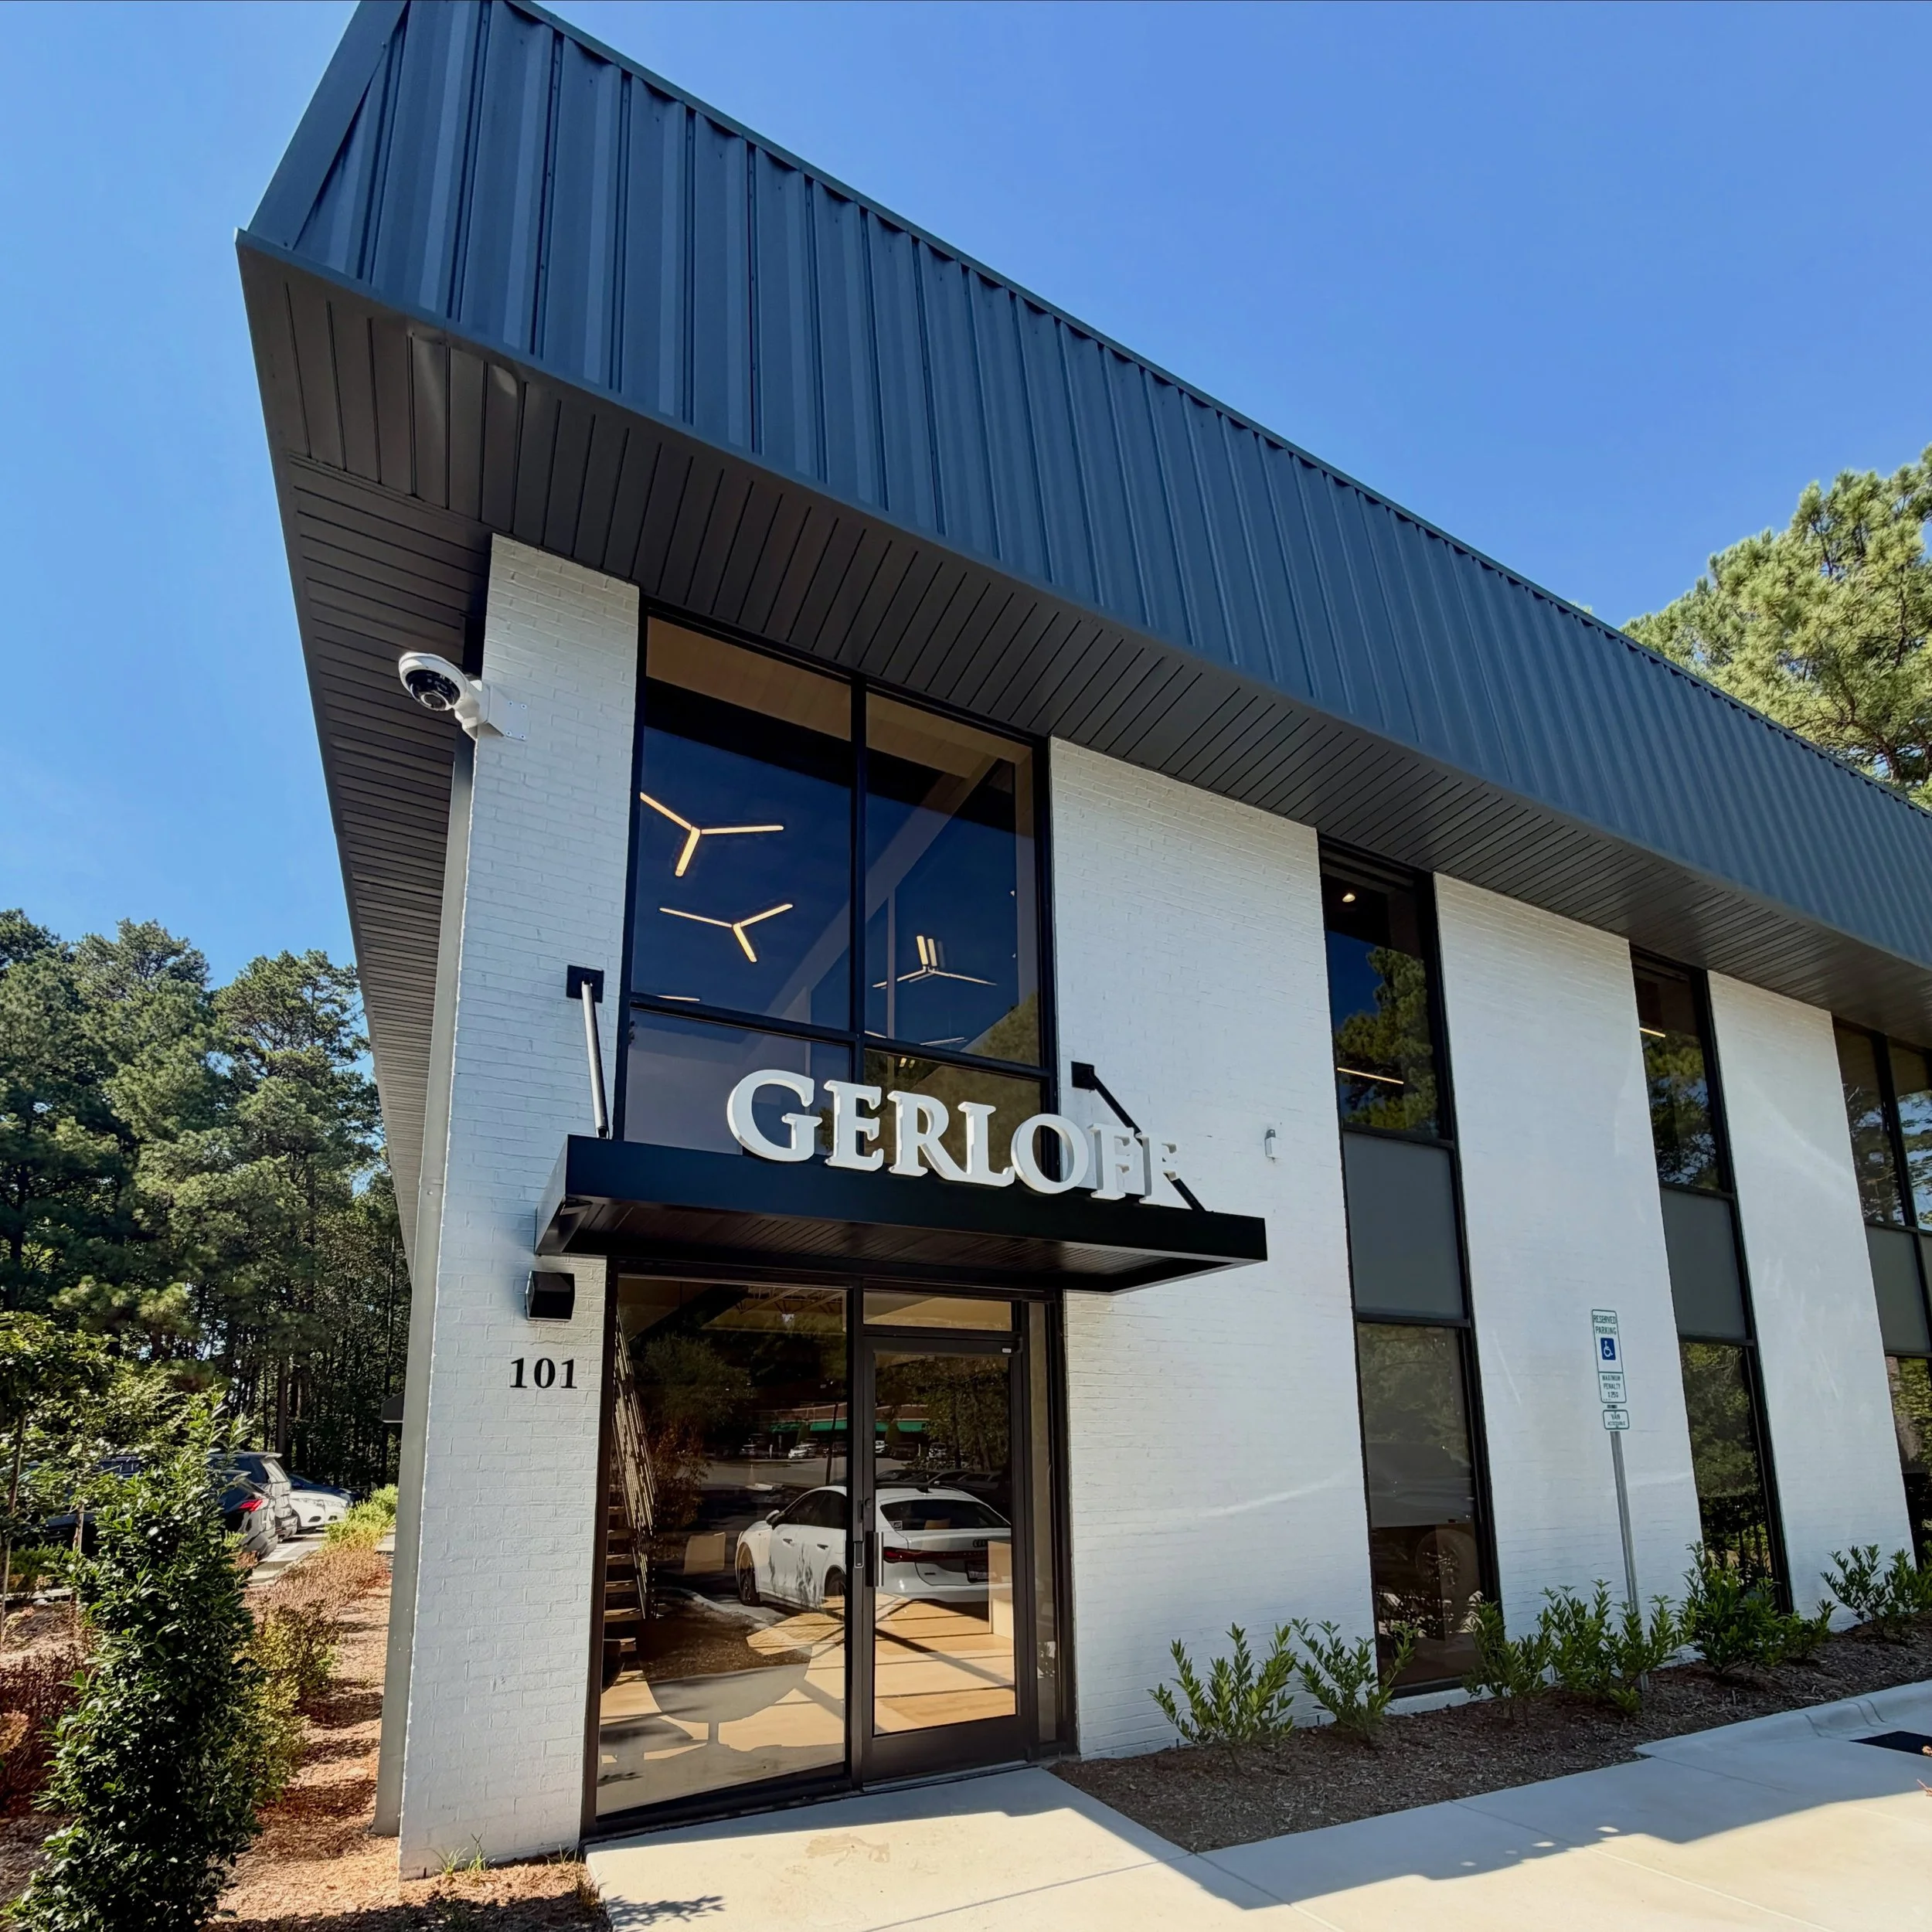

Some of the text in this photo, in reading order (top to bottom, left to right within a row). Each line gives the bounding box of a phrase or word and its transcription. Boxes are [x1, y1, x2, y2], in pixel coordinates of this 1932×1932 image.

[726, 1069, 1179, 1206] GERLOFF
[1593, 1315, 1617, 1324] RESERVED
[1595, 1325, 1617, 1335] PARKING
[510, 1358, 577, 1389] 101
